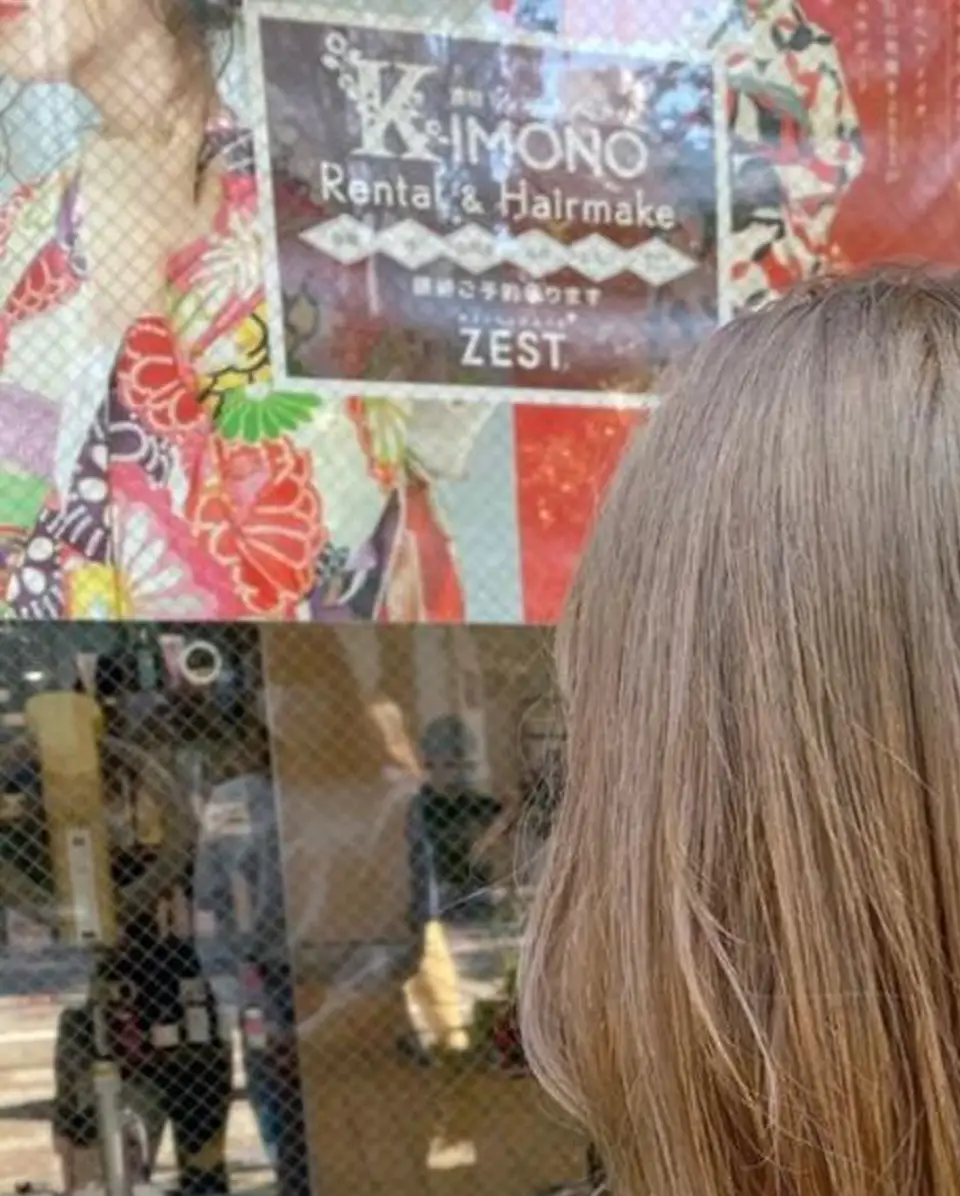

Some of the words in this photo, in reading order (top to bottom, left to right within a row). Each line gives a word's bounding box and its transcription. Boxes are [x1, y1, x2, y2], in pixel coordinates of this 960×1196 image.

[344, 54, 649, 179] KIMONO
[320, 160, 446, 211] Rental
[461, 184, 485, 215] &
[500, 179, 676, 230] Hairmake
[458, 327, 567, 371] ZEST
